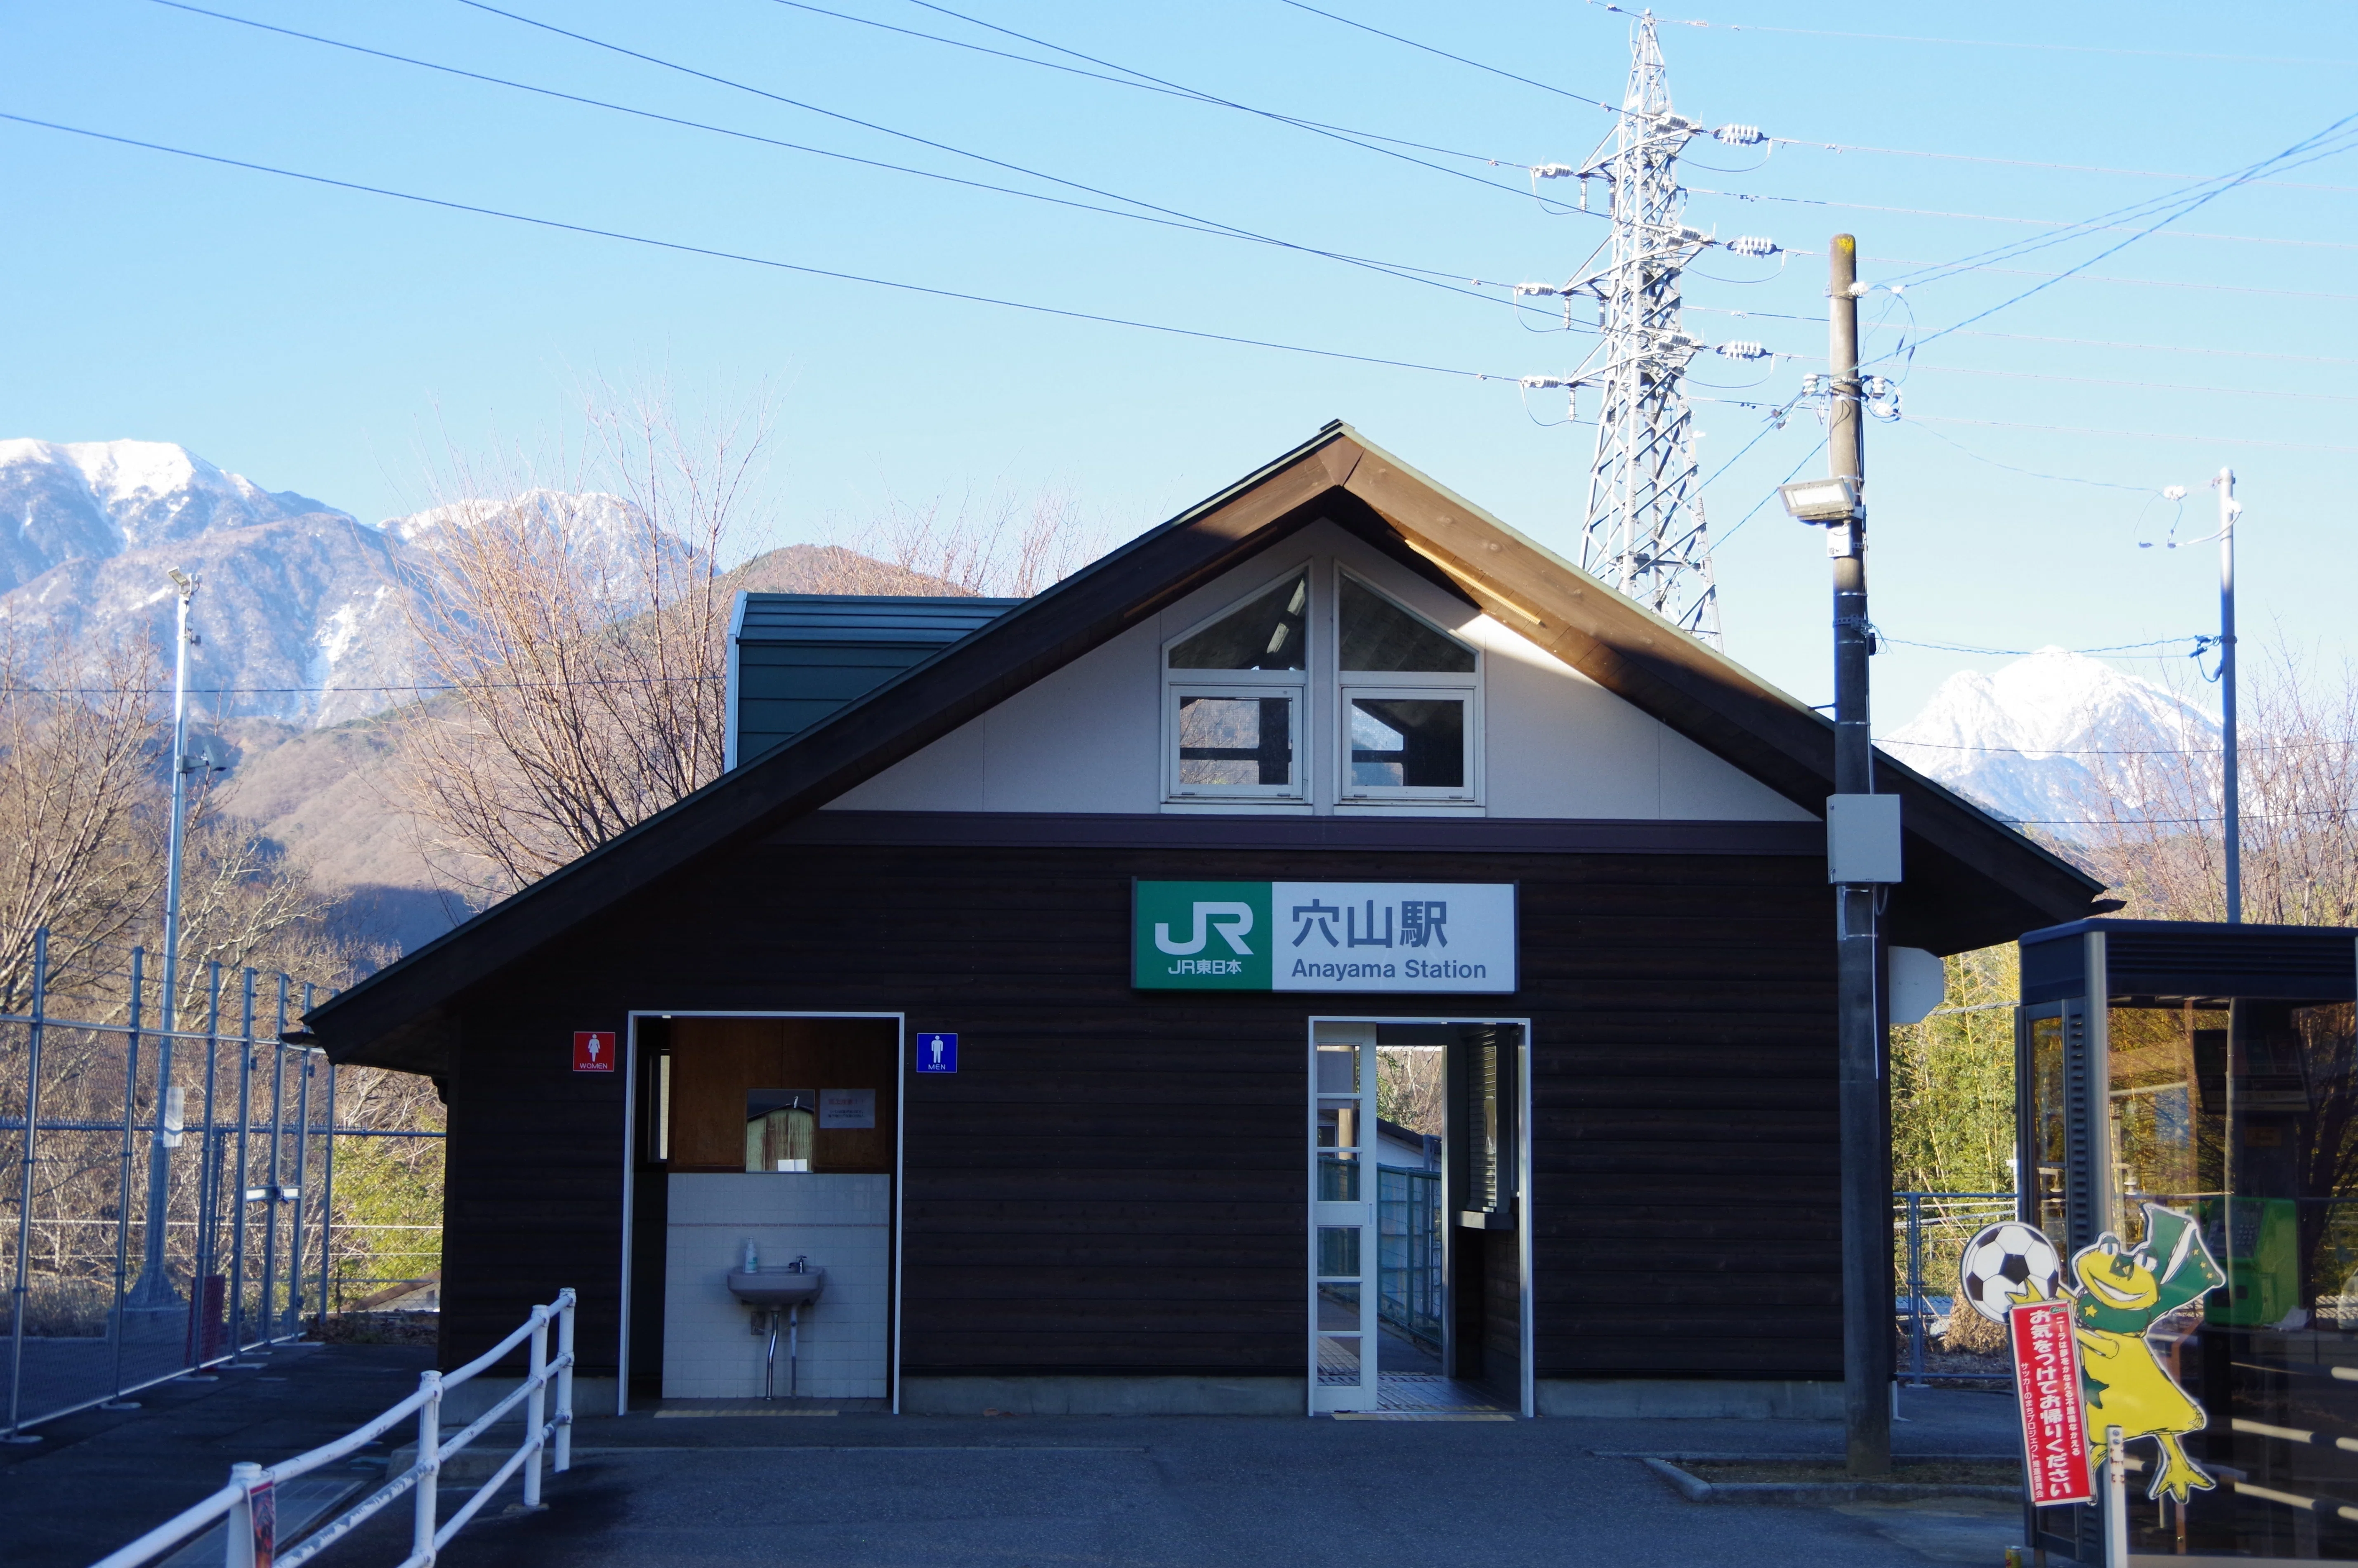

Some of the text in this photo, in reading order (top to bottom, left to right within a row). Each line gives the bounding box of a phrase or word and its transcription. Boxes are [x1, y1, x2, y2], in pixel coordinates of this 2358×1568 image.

[1155, 902, 1254, 955] JR
[1292, 899, 1448, 949] 穴山駅
[1168, 959, 1242, 975] JR東日本
[1292, 959, 1486, 982] Anayama Station
[2030, 1309, 2071, 1497] お気をつけてお帰りください
